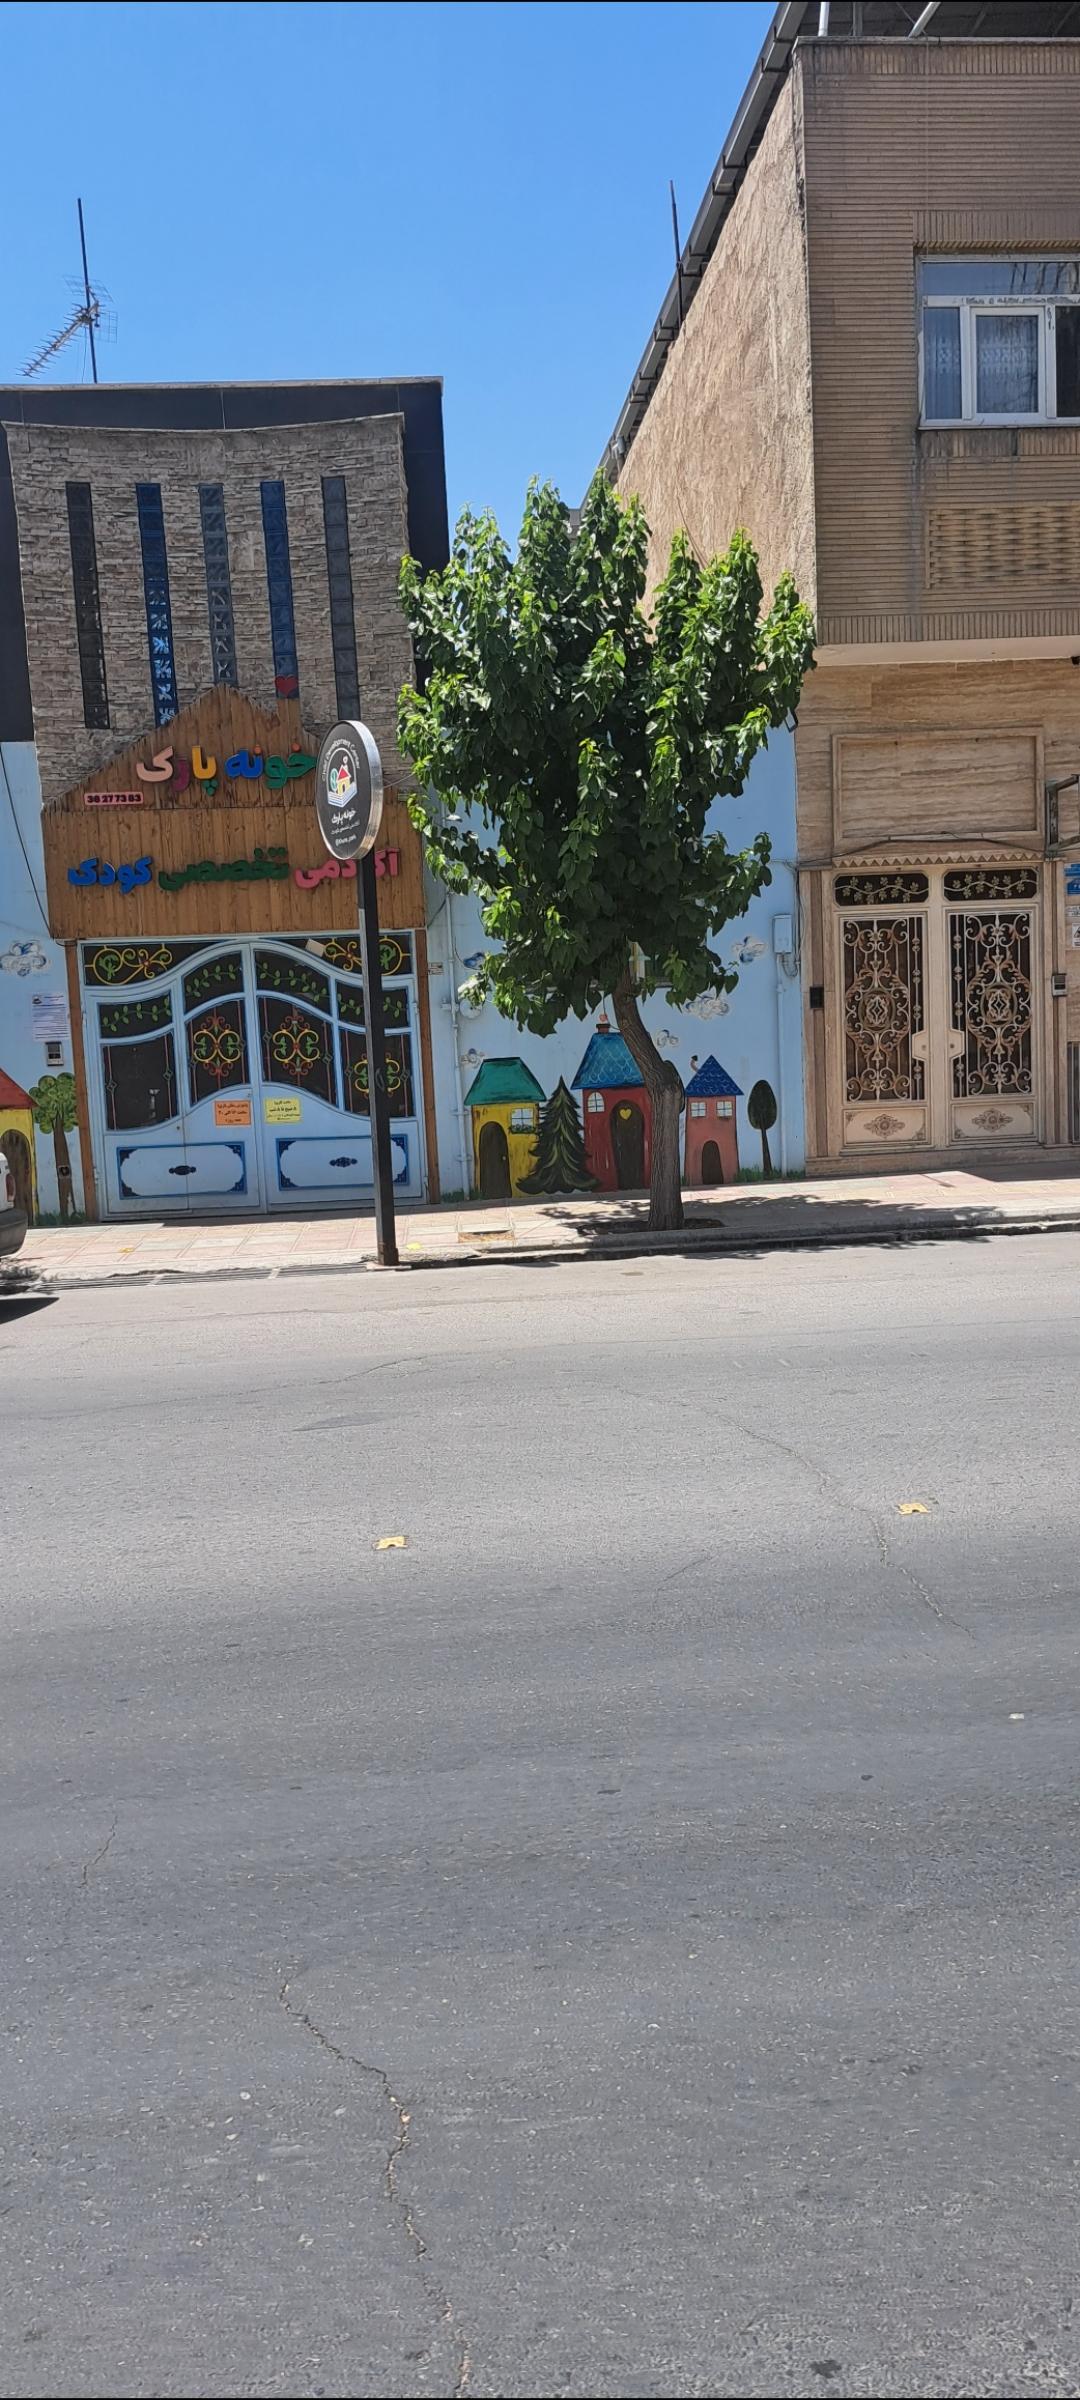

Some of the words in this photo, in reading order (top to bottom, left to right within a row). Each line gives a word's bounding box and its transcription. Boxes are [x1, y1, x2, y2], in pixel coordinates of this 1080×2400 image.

[136, 745, 219, 796] پارک
[224, 743, 317, 790] خونه
[68, 856, 153, 894] کودک
[158, 847, 290, 892] تخصصی
[294, 848, 400, 888] آکدمی
